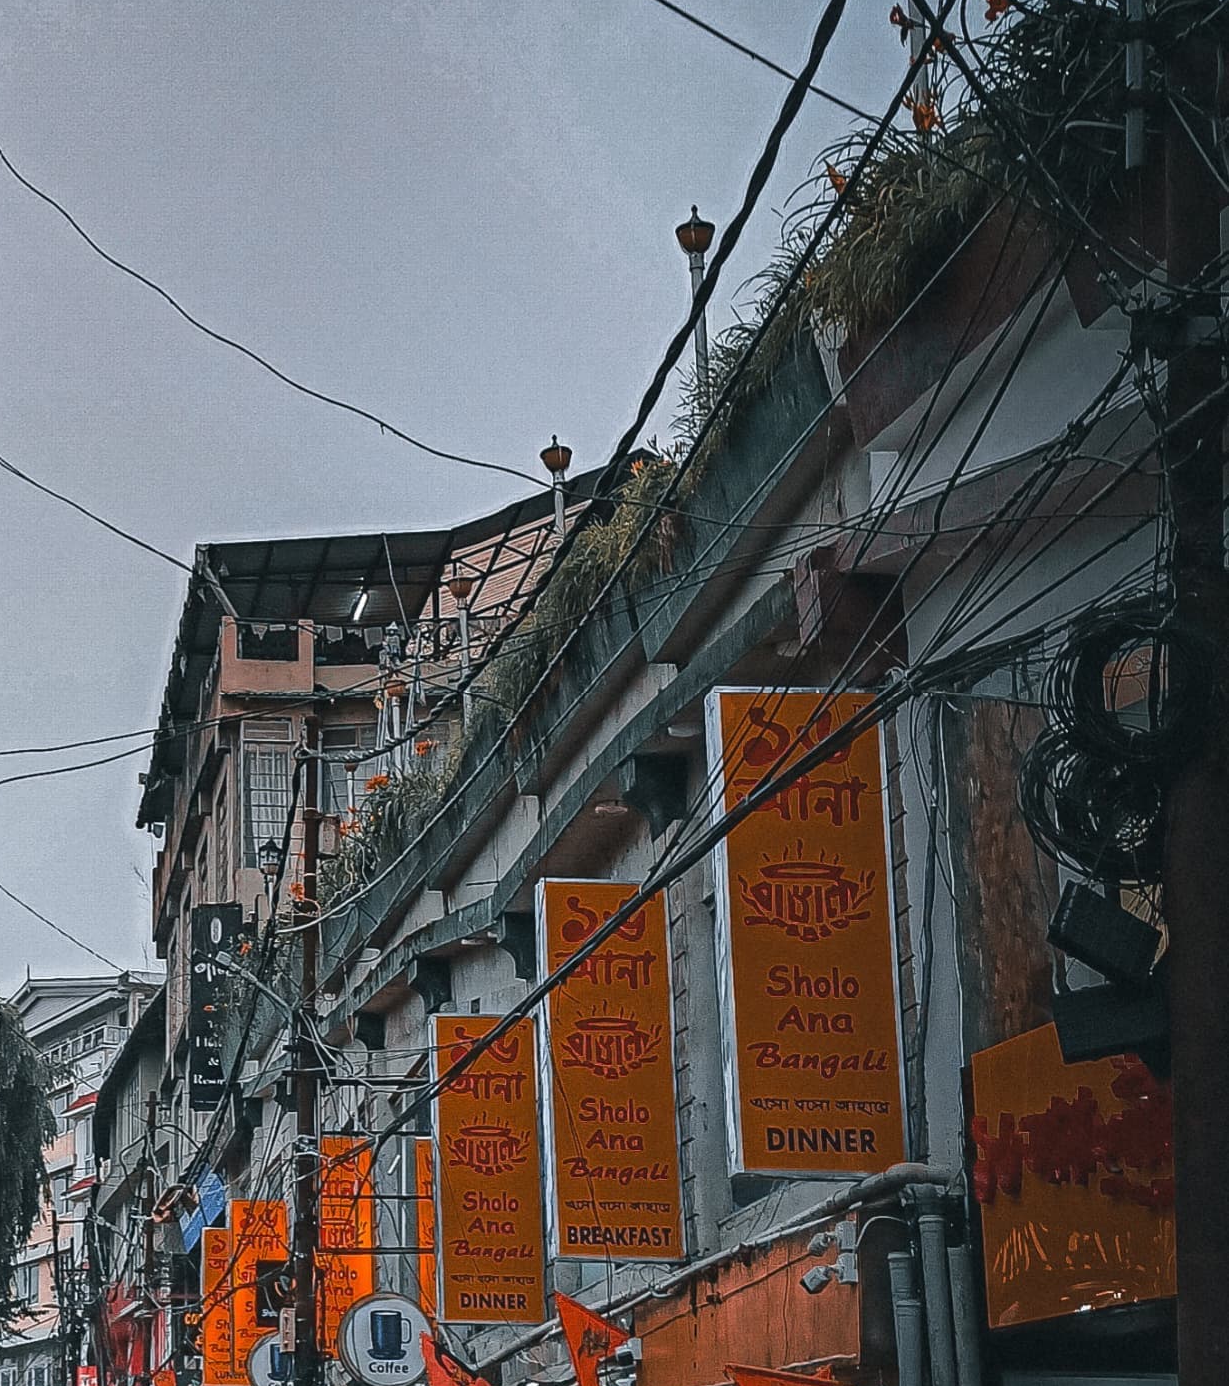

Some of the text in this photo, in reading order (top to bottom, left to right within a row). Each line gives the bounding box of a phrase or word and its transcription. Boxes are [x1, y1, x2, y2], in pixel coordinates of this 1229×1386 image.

[765, 964, 860, 1000] Sholo
[776, 1004, 855, 1035] Ana
[578, 1098, 651, 1125] Sholo
[585, 1129, 644, 1151] Ana
[765, 1126, 878, 1154] DINNER
[462, 1191, 519, 1213] Sholo
[468, 1217, 516, 1235] Ana
[567, 1225, 672, 1247] BREAKFAST
[460, 1292, 528, 1310] DINNER
[368, 1361, 410, 1374] Coffee
